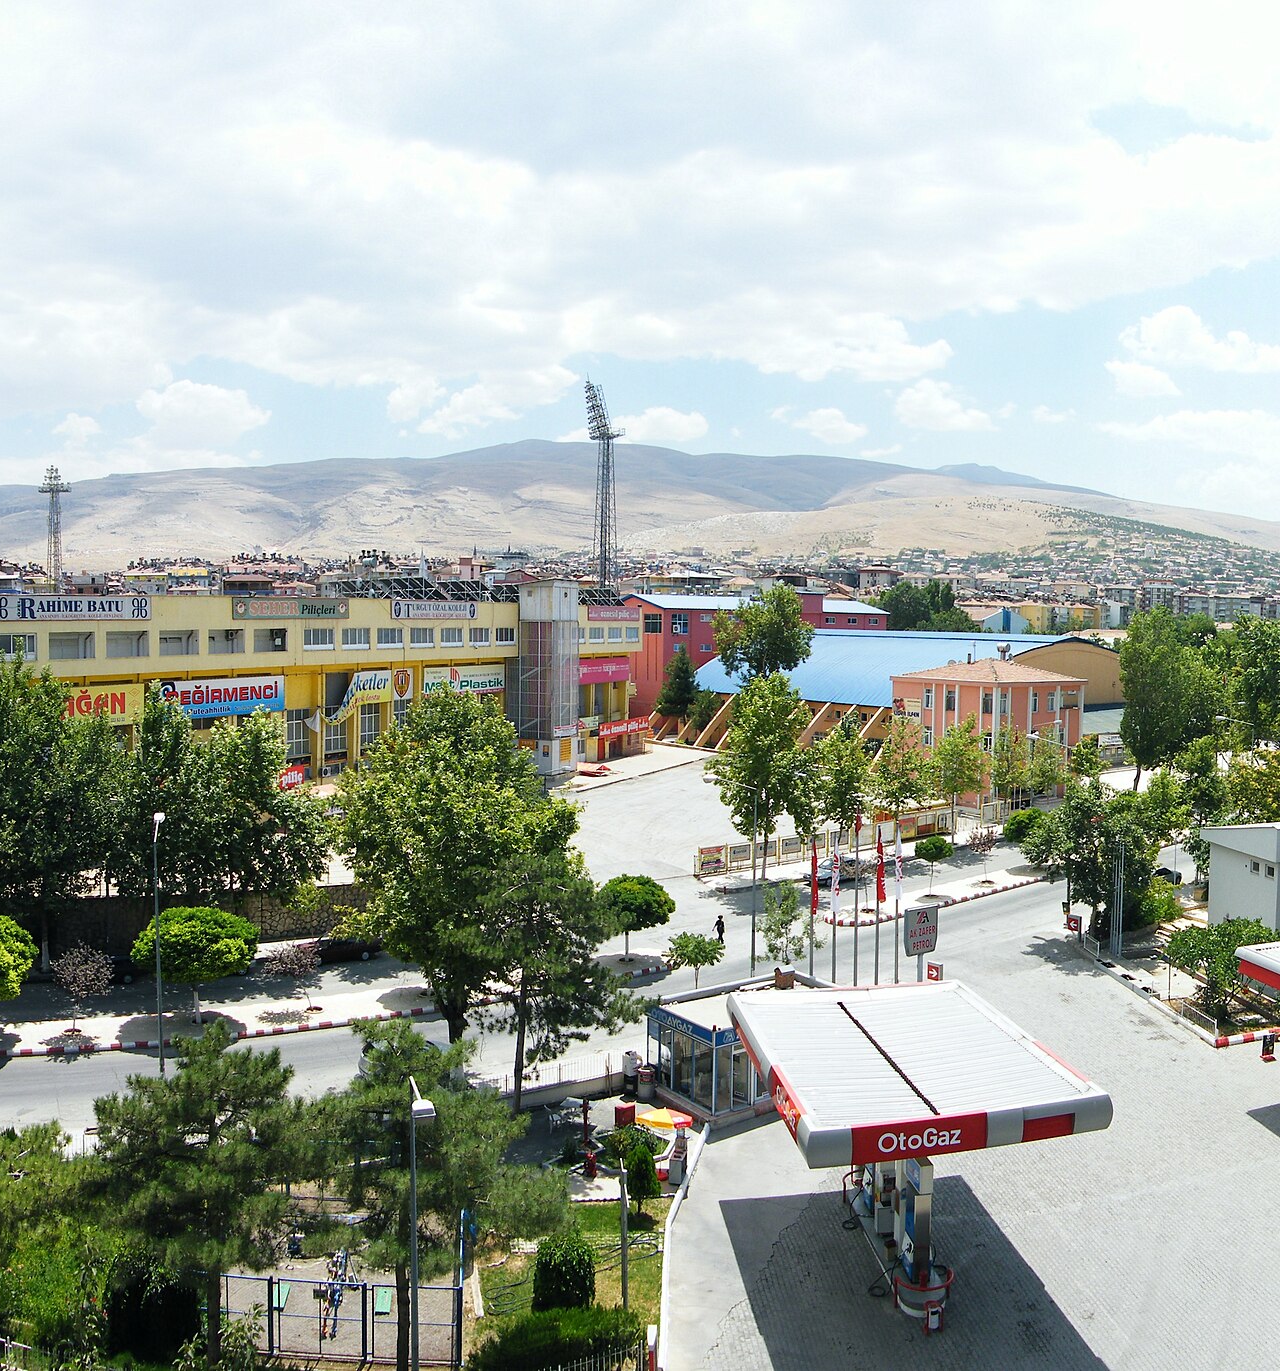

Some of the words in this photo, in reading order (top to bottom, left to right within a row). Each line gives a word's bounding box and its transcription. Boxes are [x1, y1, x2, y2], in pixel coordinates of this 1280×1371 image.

[19, 597, 83, 619] RAHİME
[87, 600, 124, 612] BATU
[249, 600, 299, 616] SEHER
[301, 604, 336, 617] Piliçleri
[425, 680, 455, 693] Mat
[460, 678, 503, 690] Plastik
[281, 770, 303, 787] piliç
[910, 930, 918, 939] AK
[919, 926, 936, 936] ZAFER
[913, 939, 933, 950] PETROL
[877, 1127, 962, 1153] OtoGaz
